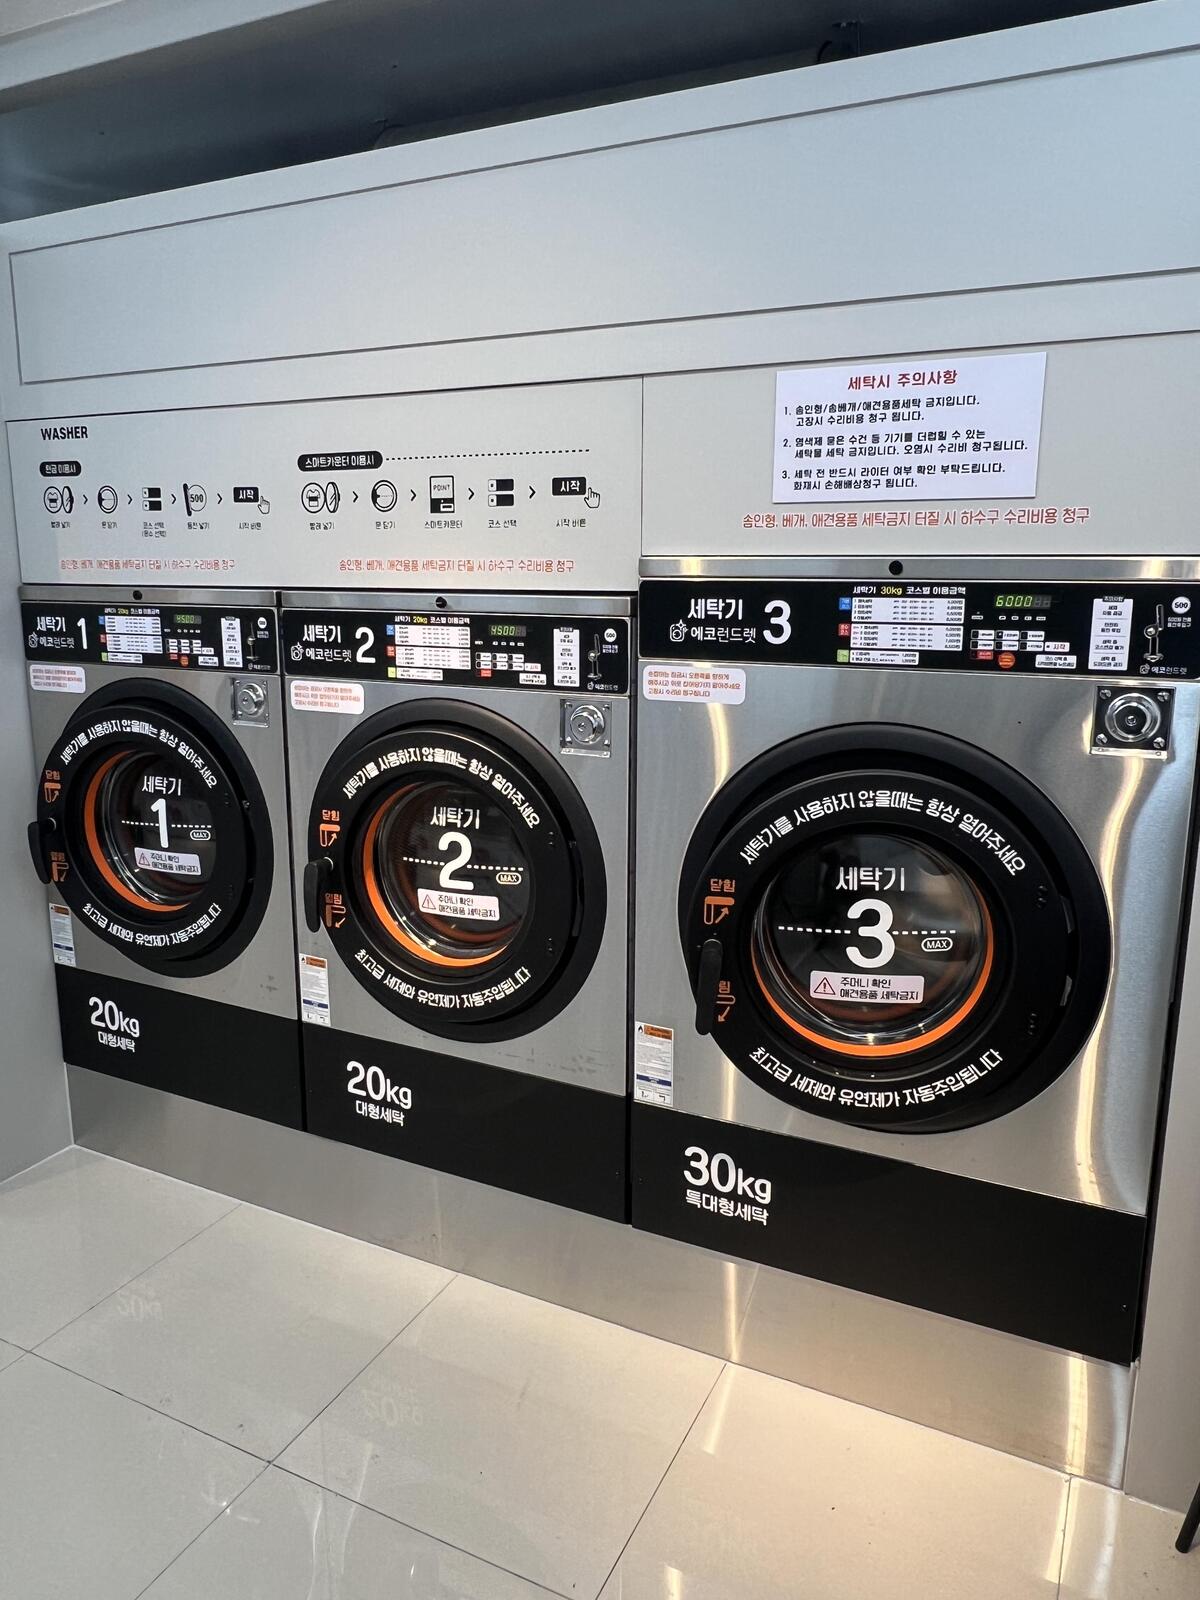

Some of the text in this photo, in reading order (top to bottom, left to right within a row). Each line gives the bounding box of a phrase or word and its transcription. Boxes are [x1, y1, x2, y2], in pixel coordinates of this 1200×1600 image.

[848, 369, 958, 390] 세탁시 주의사항
[784, 406, 792, 416] 1.
[926, 395, 980, 408] 금지입니다.
[796, 411, 924, 427] 고장시 수리비용 청구 됩니다.
[41, 426, 89, 441] WASHER
[783, 428, 986, 448] 2. 염색제 묻은 수건 등 기기를 더럽힐 수 있는
[795, 439, 1028, 459] 세탁물 세탁 금지입니다. 오염시 수리비 청구됩니다.
[305, 455, 375, 469] 스마트카운터 이용시
[782, 462, 1005, 480] 3. 세탁 전 반드시 라이터 여부 확인 부탁드립니다.
[432, 484, 451, 492] POINT
[560, 480, 581, 493] 시작
[793, 476, 918, 491] 화재시 손해배상청구 됩니다.
[190, 493, 204, 503] 500
[239, 489, 254, 501] 시작
[424, 520, 463, 530] 스마트카운터
[488, 519, 517, 529] 코스 선택
[556, 518, 587, 528] 시작 버튼
[811, 510, 858, 528] 애견용품
[861, 510, 911, 527] 세탁금지
[915, 509, 940, 526] 터질
[944, 509, 956, 526] 시
[960, 508, 1000, 526] 하수구
[1003, 506, 1057, 525] 수리비용
[1061, 506, 1090, 525] 청구
[421, 559, 455, 572] 세탁금지
[457, 560, 475, 572] 터질
[477, 560, 486, 572] 시
[488, 560, 515, 572] 하수구
[518, 560, 554, 573] 수리비용
[556, 560, 575, 573] 청구
[853, 586, 876, 594] 세탁기
[880, 586, 903, 596] 30kg
[687, 598, 743, 620] 세탁기
[996, 595, 1033, 607] 6000
[1174, 601, 1188, 609] 500
[36, 616, 66, 632] 세탁기
[762, 600, 792, 645] 3
[39, 636, 75, 649] 에코런드렛
[77, 617, 88, 650] 1
[302, 624, 342, 644] 세탁기
[690, 626, 756, 643] 에코런드렛
[355, 626, 377, 664] 2
[305, 647, 352, 663] 에코런드렛
[60, 719, 218, 790] 세탁기를 사용하지 않을때는 항상 열어주세요
[141, 775, 182, 796] 세탁기
[342, 746, 540, 830] 세탁기를 사용하지 않을때는 항상 열어주세요
[150, 798, 169, 849] 1
[430, 806, 480, 830] 세탁기
[192, 831, 208, 839] MAX
[740, 789, 1026, 877] 세탁기를 사용하지 않을때는 항상 열어주세요
[438, 831, 474, 891] 2
[500, 874, 518, 882] MAX
[710, 878, 736, 893] 닫힘
[835, 866, 905, 892] 세탁기
[438, 894, 474, 906] 주머니 확인
[467, 907, 496, 918] 세탁금지
[82, 902, 222, 947] 최고급 세제와 유연제가 자동주입됩니다
[845, 898, 896, 969] 3
[926, 940, 948, 949] MAX
[354, 948, 532, 1009] 최고급 세제와 유연제가 자동주입됩니다
[718, 980, 731, 994] 림
[841, 976, 892, 989] 주머니 확인
[840, 990, 919, 1001] 애견용품 세탁금지
[88, 996, 140, 1038] 20kg
[97, 1030, 136, 1053] 대형세탁
[346, 1060, 412, 1110] 20kg
[749, 1046, 1003, 1109] 최고급 세제와 유연제가 자동주입됩니다
[355, 1099, 405, 1127] 대형세탁
[683, 1146, 772, 1205] 30kg
[685, 1189, 769, 1226] 특대형세탁
